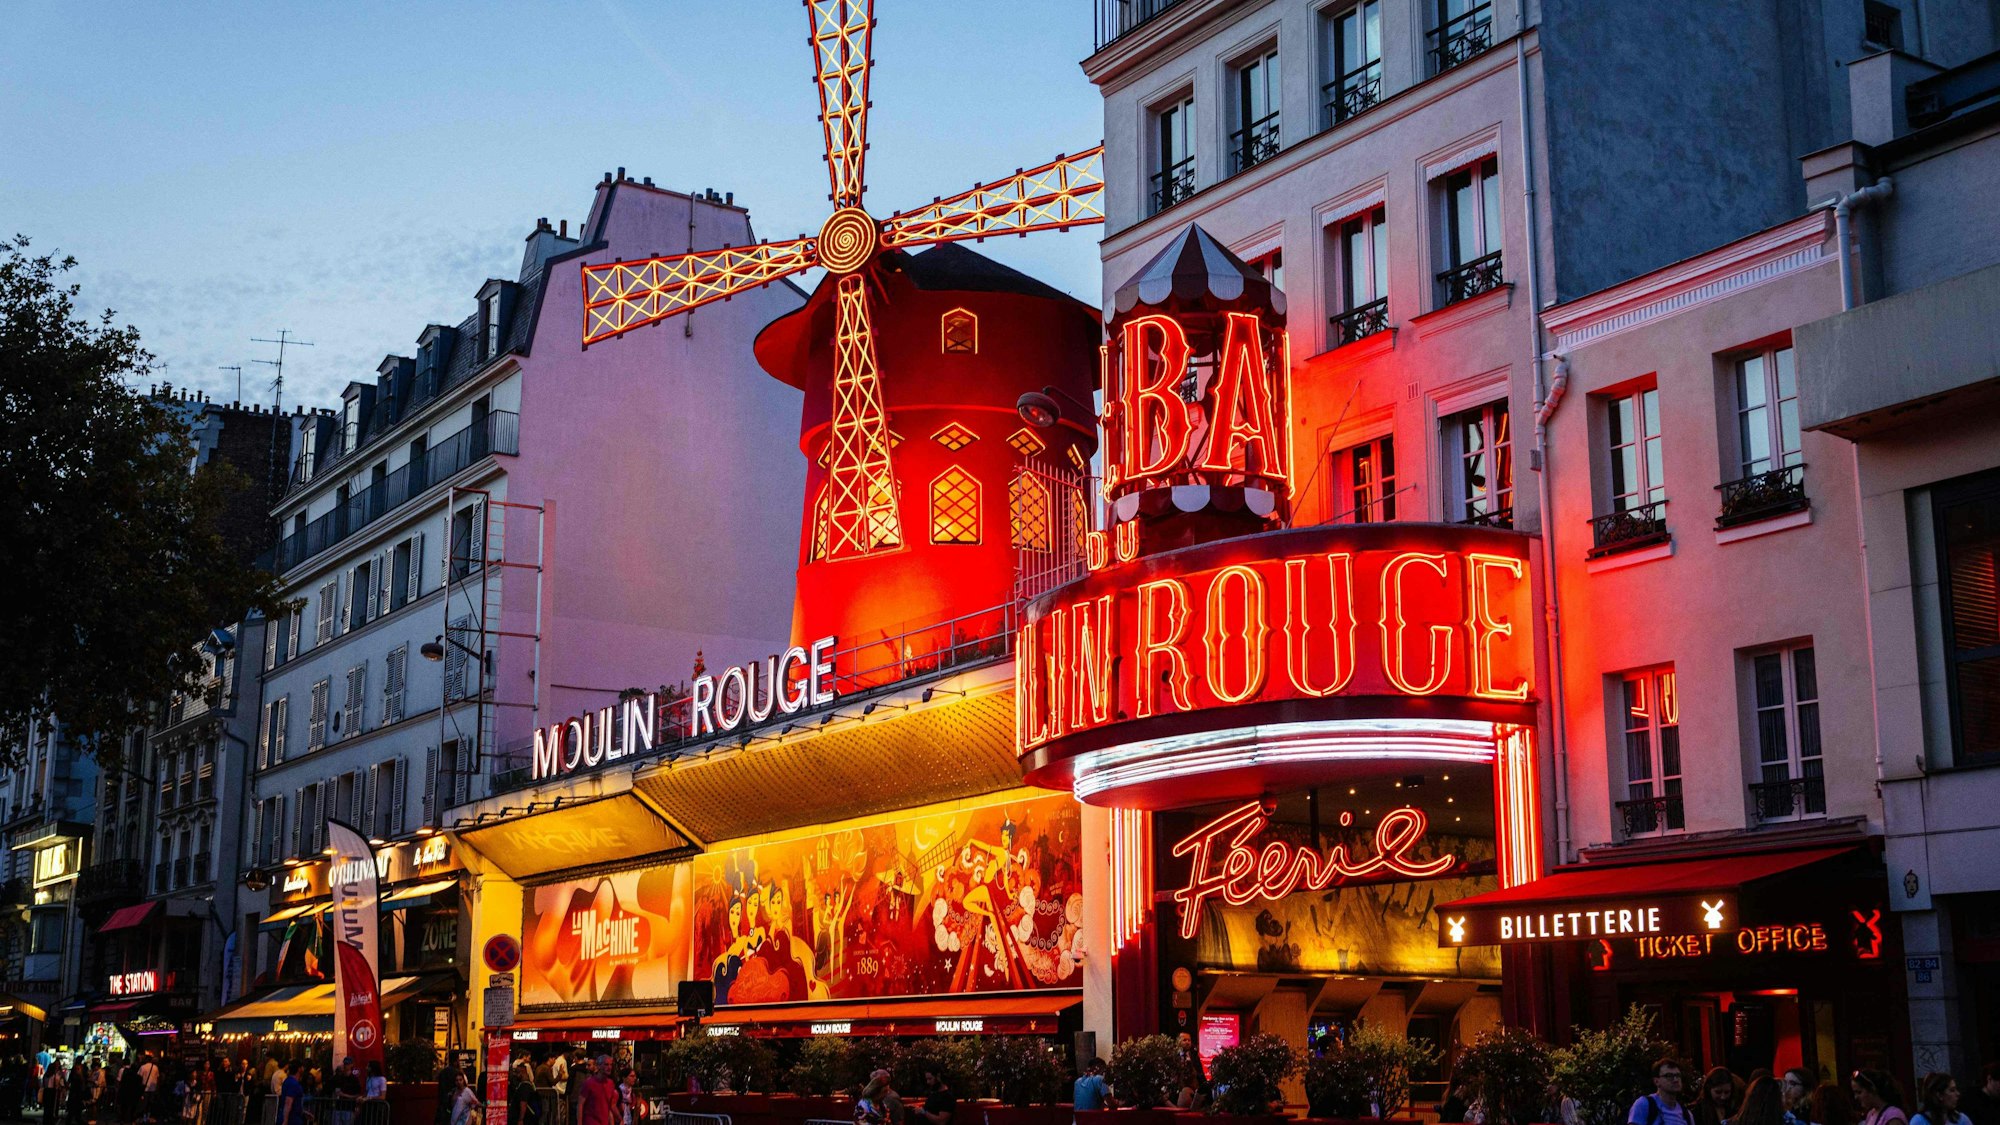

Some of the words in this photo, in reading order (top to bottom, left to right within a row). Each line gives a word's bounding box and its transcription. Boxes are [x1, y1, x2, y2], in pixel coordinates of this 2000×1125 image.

[1086, 521, 1139, 571] DU
[1135, 552, 1529, 718] ROUGE
[532, 692, 657, 780] MOULIN
[692, 635, 838, 738] ROUGE
[1173, 801, 1455, 939] Féerie
[421, 919, 457, 951] ZONE
[572, 911, 582, 932] LA
[1500, 907, 1661, 939] BILLETTERIE
[1635, 934, 1712, 960] TICKET
[1737, 924, 1828, 953] OFFICE
[857, 957, 879, 978] 1889
[1908, 960, 1921, 969] 82
[1925, 959, 1937, 968] 84
[109, 975, 122, 994] THE
[125, 971, 154, 994] STATION
[811, 1024, 831, 1034] MOULIN
[832, 1023, 851, 1033] ROUGE
[936, 1021, 960, 1032] MOULIN
[961, 1020, 983, 1031] ROUGE
